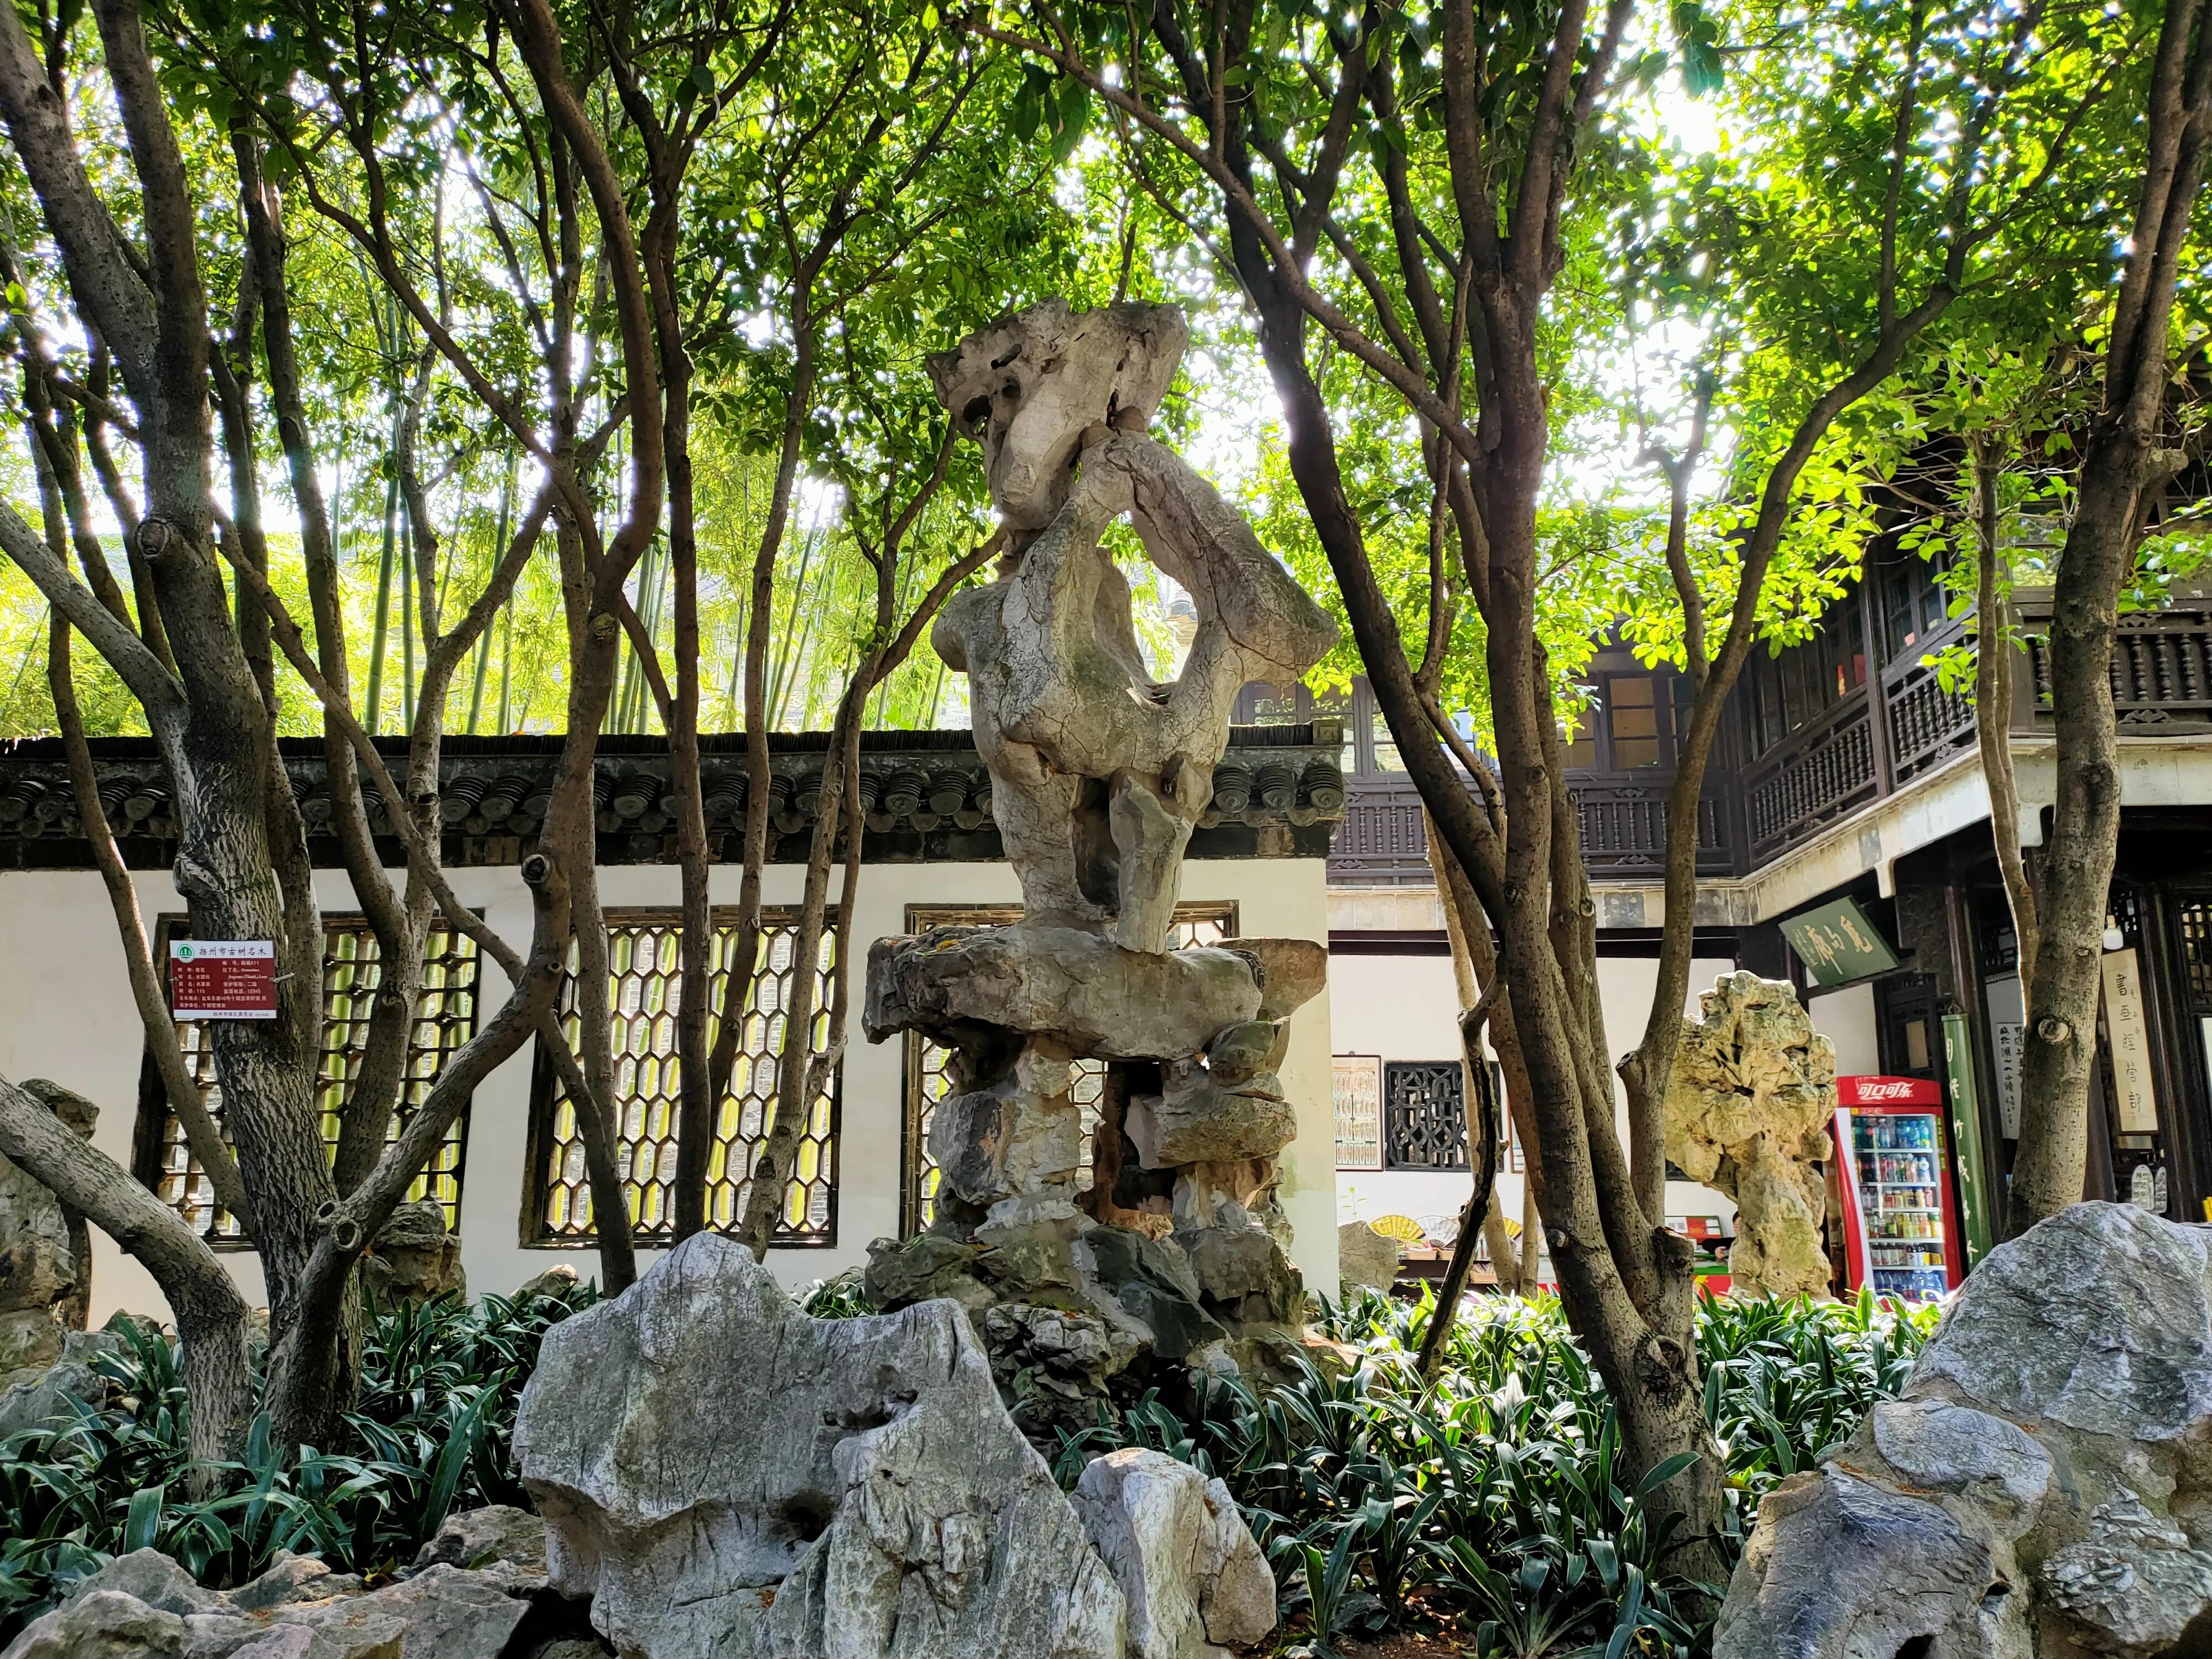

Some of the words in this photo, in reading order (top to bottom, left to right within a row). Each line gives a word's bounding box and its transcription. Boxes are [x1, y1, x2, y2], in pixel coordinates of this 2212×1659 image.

[199, 946, 267, 956] 扬州市古树名木
[1858, 1082, 1915, 1100] 可口可乐
